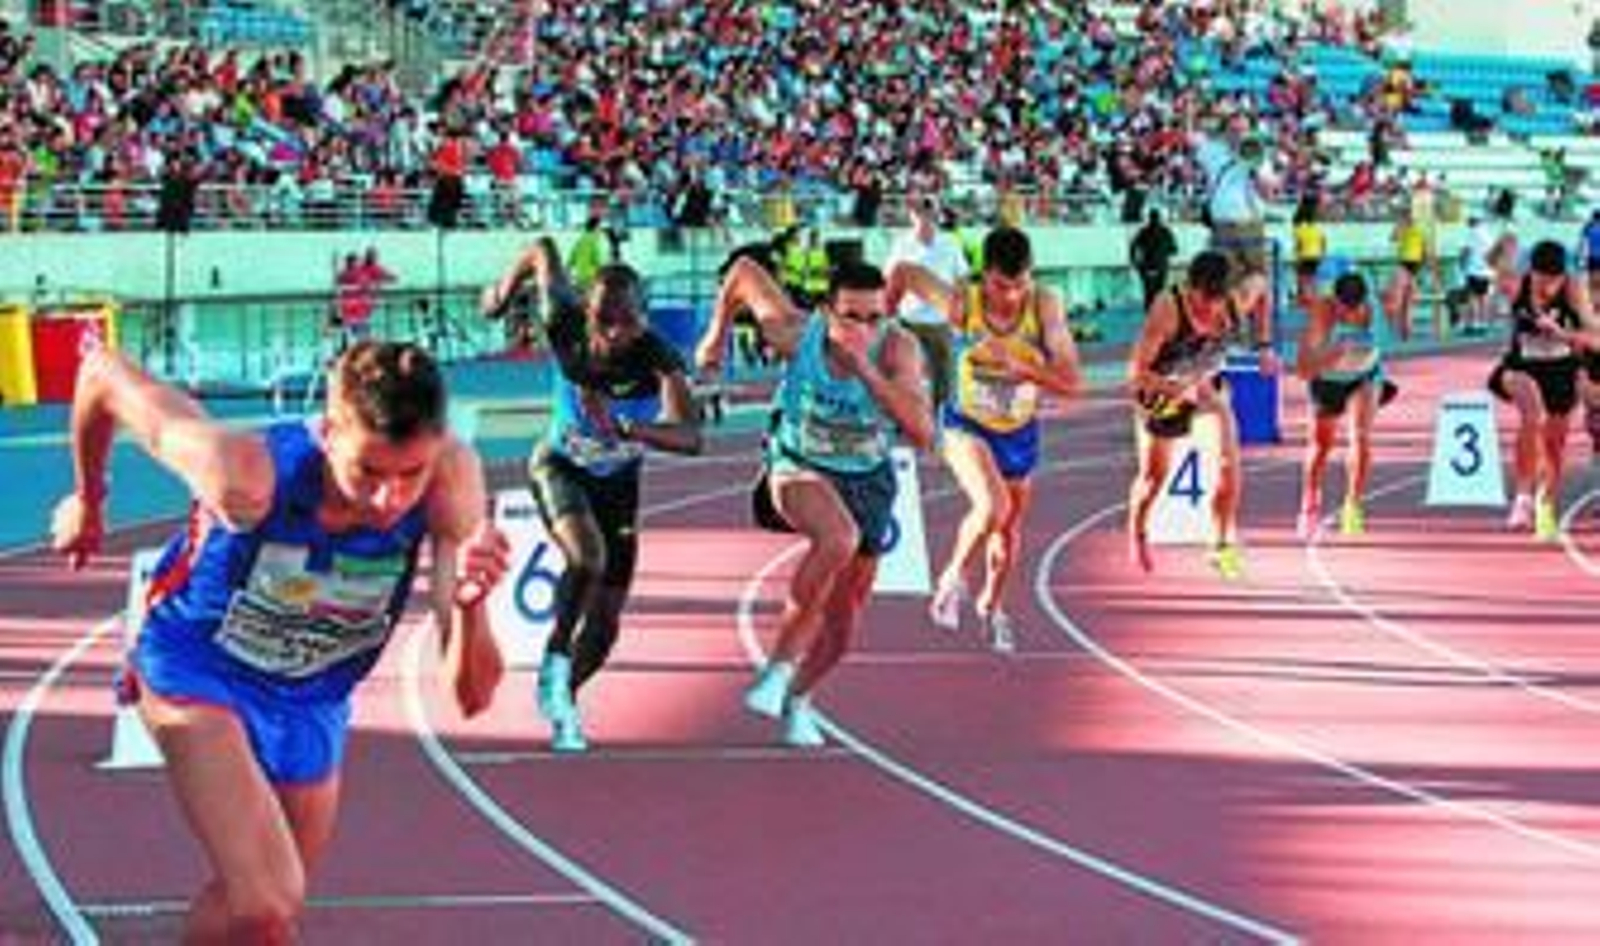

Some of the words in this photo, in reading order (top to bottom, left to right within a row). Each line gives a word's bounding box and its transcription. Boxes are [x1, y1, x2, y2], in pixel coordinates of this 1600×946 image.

[1167, 448, 1207, 508] 4
[1449, 422, 1483, 477] 3
[513, 540, 562, 623] 6
